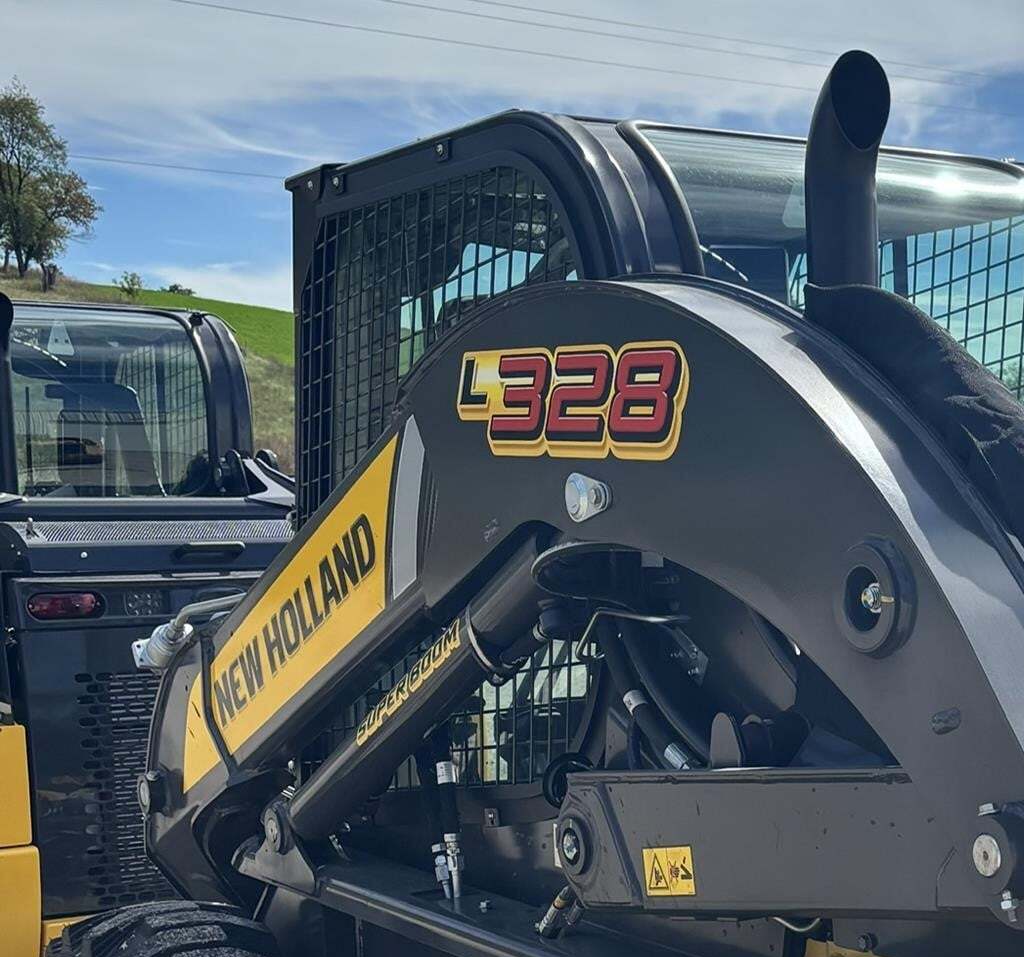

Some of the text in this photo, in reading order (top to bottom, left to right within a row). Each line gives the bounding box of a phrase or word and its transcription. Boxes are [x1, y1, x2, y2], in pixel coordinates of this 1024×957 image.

[458, 342, 689, 459] L328
[213, 513, 376, 726] NEW HOLLAND
